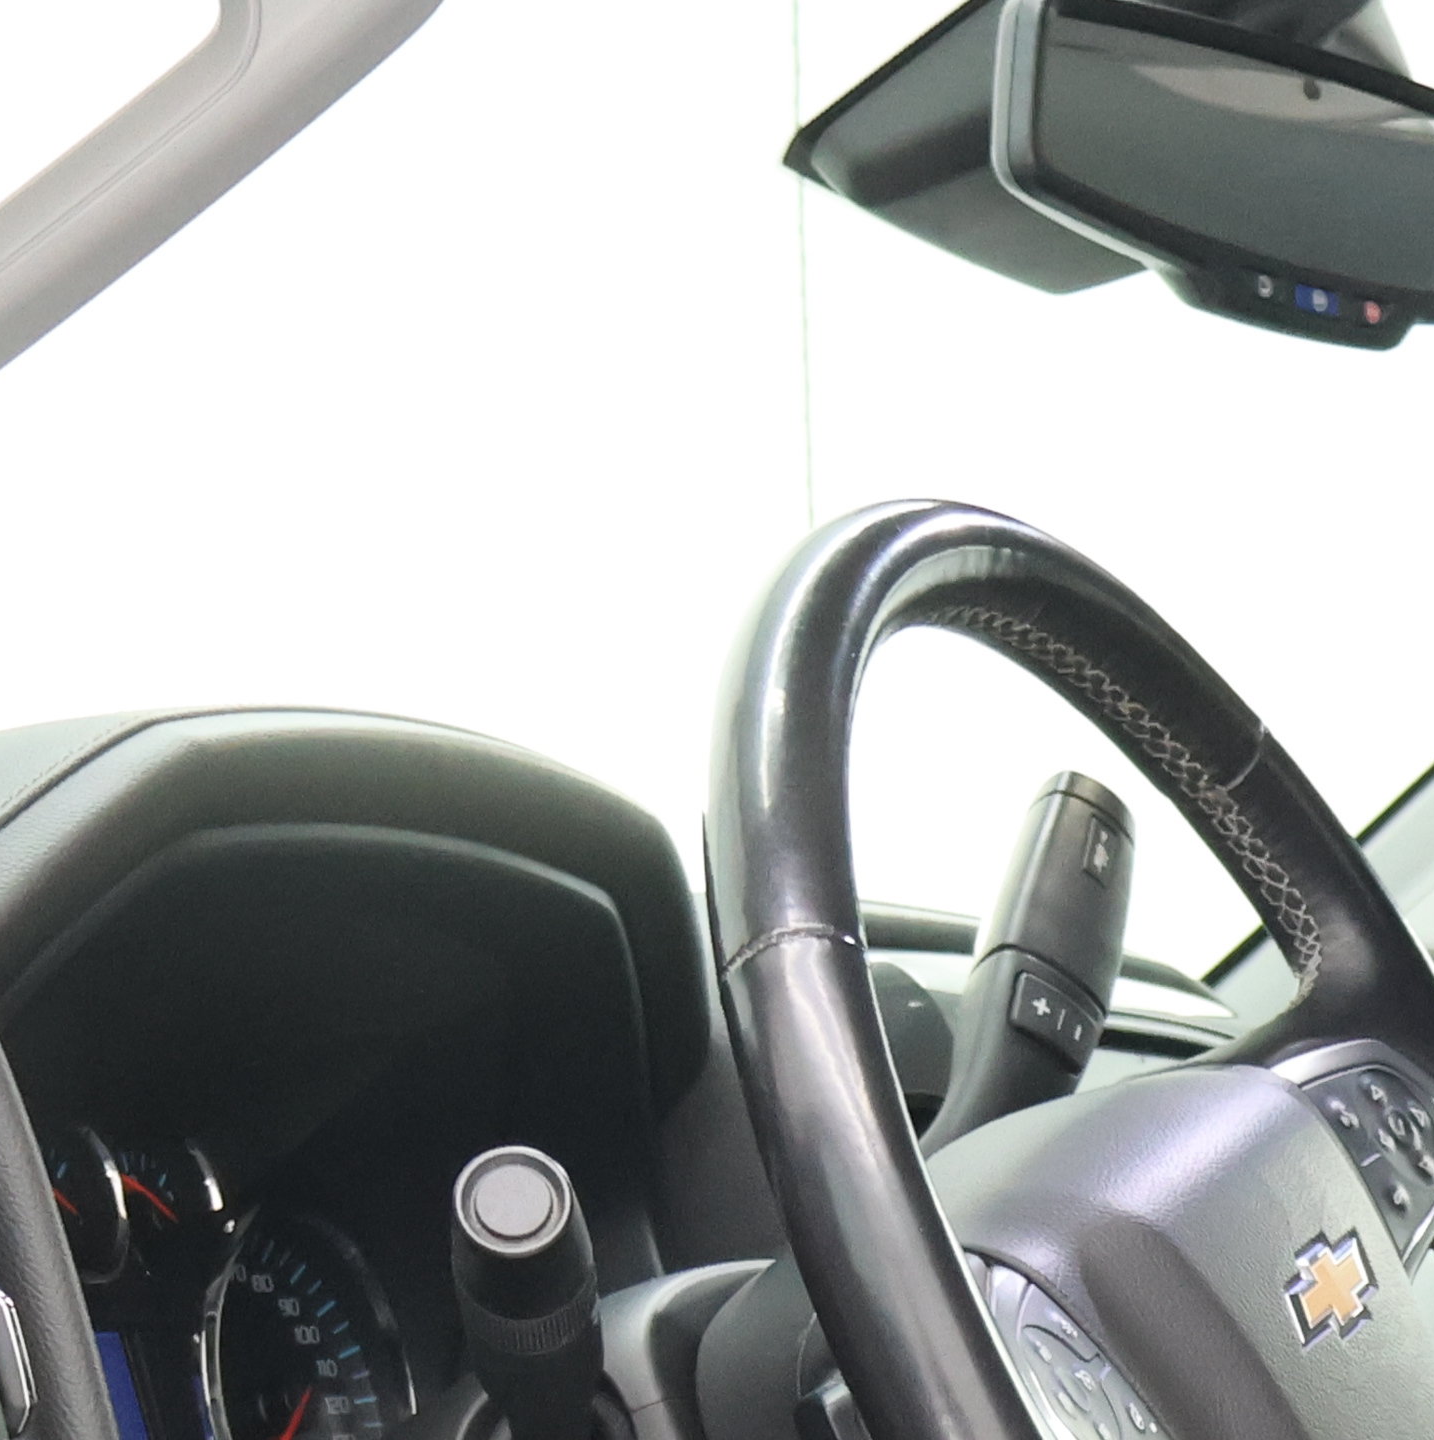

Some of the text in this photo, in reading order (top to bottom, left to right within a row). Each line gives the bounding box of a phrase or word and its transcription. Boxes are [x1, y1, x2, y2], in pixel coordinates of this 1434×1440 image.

[251, 1274, 275, 1293] 80
[277, 1298, 300, 1318] 90
[294, 1325, 321, 1345] 100
[316, 1358, 338, 1378] 110
[324, 1396, 351, 1415] 120
